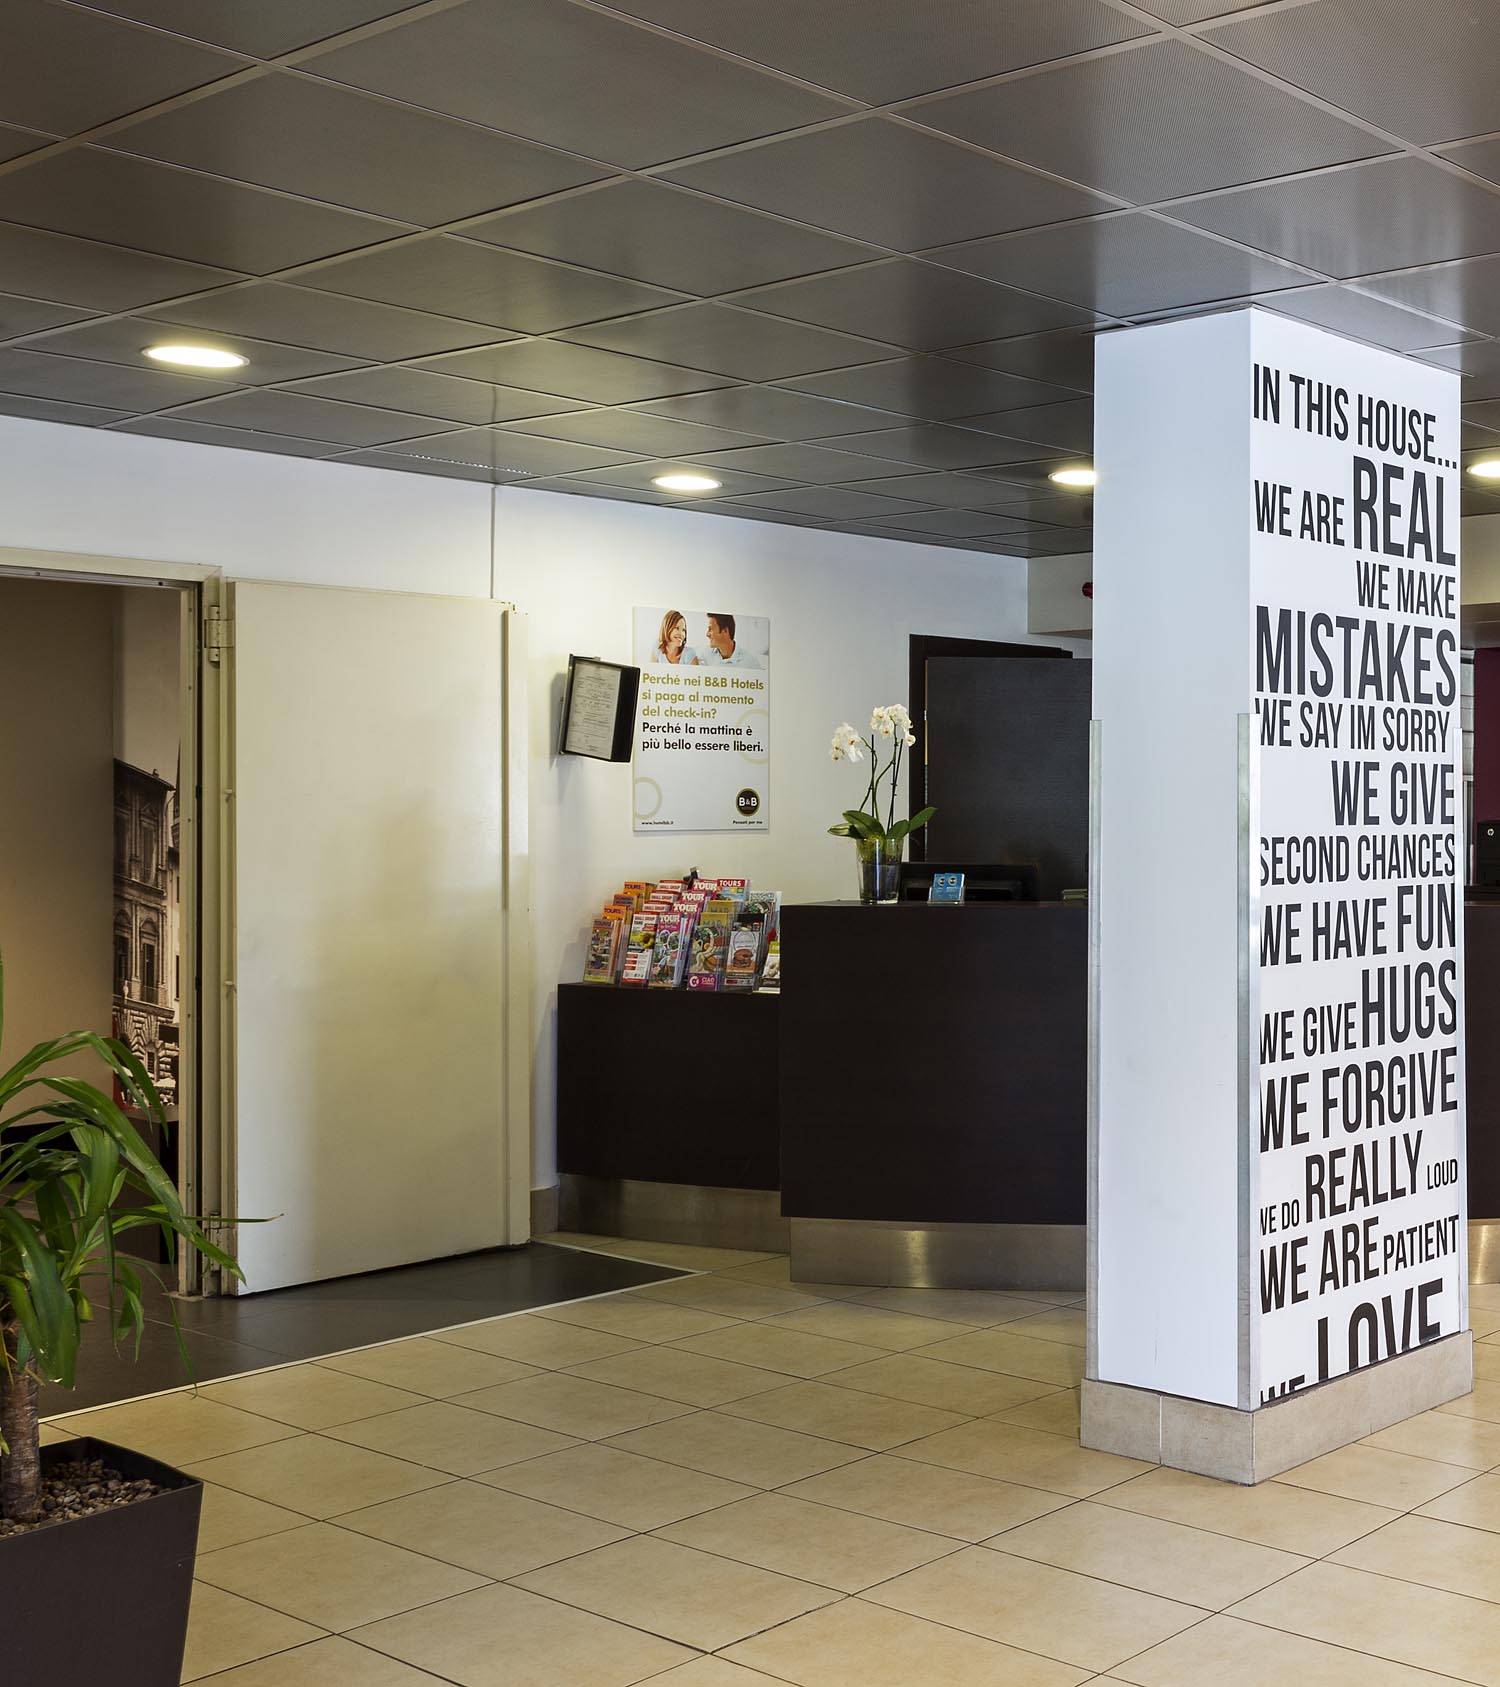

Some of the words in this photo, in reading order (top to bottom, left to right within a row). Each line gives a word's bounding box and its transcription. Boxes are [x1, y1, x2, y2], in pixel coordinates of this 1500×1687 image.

[1254, 364, 1280, 424] IN
[1289, 374, 1349, 441] THIS
[1358, 394, 1457, 469] HOUSE...
[1255, 480, 1292, 537] WE
[1300, 491, 1345, 547] ARE
[1354, 456, 1456, 566] REAL
[1356, 560, 1390, 610] WE
[1398, 568, 1456, 620] MAKE
[642, 673, 680, 685] Perché
[684, 676, 701, 686] nei
[704, 676, 728, 688] B&B
[731, 678, 764, 690] Hotels
[1256, 606, 1456, 707] MISTAKES
[642, 689, 651, 700] si
[655, 692, 685, 703] paga
[688, 691, 699, 702] al
[703, 694, 754, 705] momento
[642, 705, 660, 717] del
[664, 706, 717, 719] check-in?
[642, 722, 681, 734] Perché
[685, 723, 696, 734] la
[700, 725, 743, 736] mattina
[746, 726, 753, 736] è
[642, 738, 660, 752] più
[664, 738, 692, 750] bello
[695, 742, 730, 752] essere
[733, 740, 764, 752] liberi.
[1255, 698, 1292, 747] WE
[1300, 701, 1344, 748] SAY
[1351, 704, 1376, 750] IM
[1383, 707, 1450, 753] SORRY
[739, 797, 758, 807] B&B
[1332, 761, 1380, 826] WE
[1391, 762, 1455, 825] GIVE
[1260, 836, 1350, 887] SECOND
[1358, 833, 1455, 882] CHANCES
[660, 914, 680, 923] TOUR
[673, 903, 698, 912] TOUR
[682, 892, 705, 901] TOUR
[1260, 904, 1302, 968] WE
[1313, 898, 1388, 961] HAVE
[1398, 883, 1456, 953] FUN
[1260, 1010, 1295, 1065] WE
[1303, 1002, 1357, 1057] GIVE
[1362, 960, 1457, 1049] HUGS
[1260, 1073, 1310, 1154] WE
[1323, 1047, 1458, 1139] FORGIVE
[1281, 1199, 1300, 1230] DO
[1306, 1130, 1423, 1224] REALLY
[1427, 1159, 1458, 1190] LOUD
[1260, 1236, 1309, 1315] WE
[1319, 1216, 1380, 1295] ARE
[1384, 1215, 1459, 1276] PATIENT
